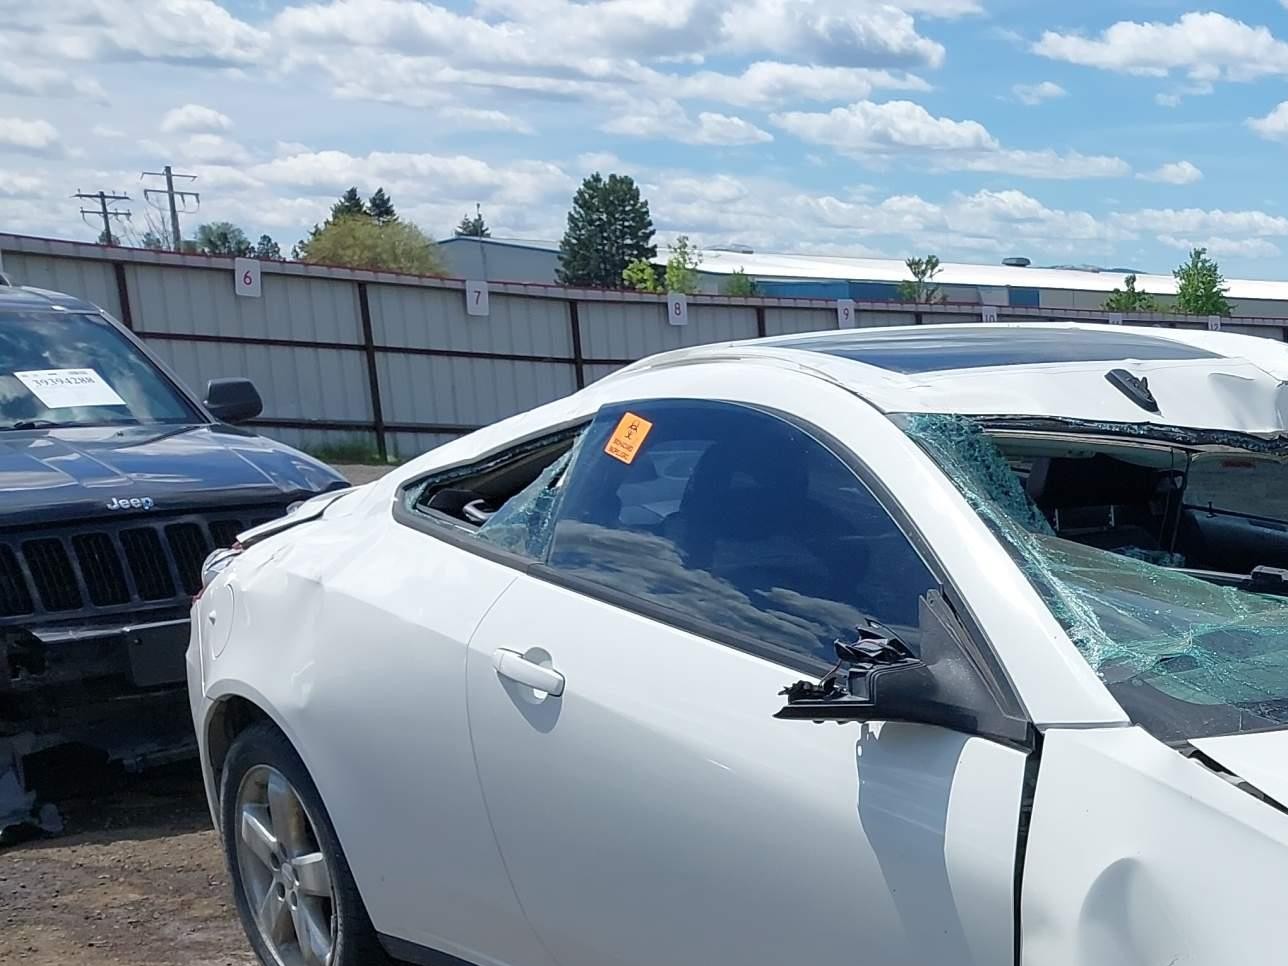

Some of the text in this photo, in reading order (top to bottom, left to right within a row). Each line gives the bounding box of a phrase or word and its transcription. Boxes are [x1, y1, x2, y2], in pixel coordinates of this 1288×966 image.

[243, 270, 252, 286] 6
[473, 290, 481, 305] 7
[674, 302, 681, 316] 8
[843, 307, 850, 321] 9
[105, 497, 154, 511] Jeep
